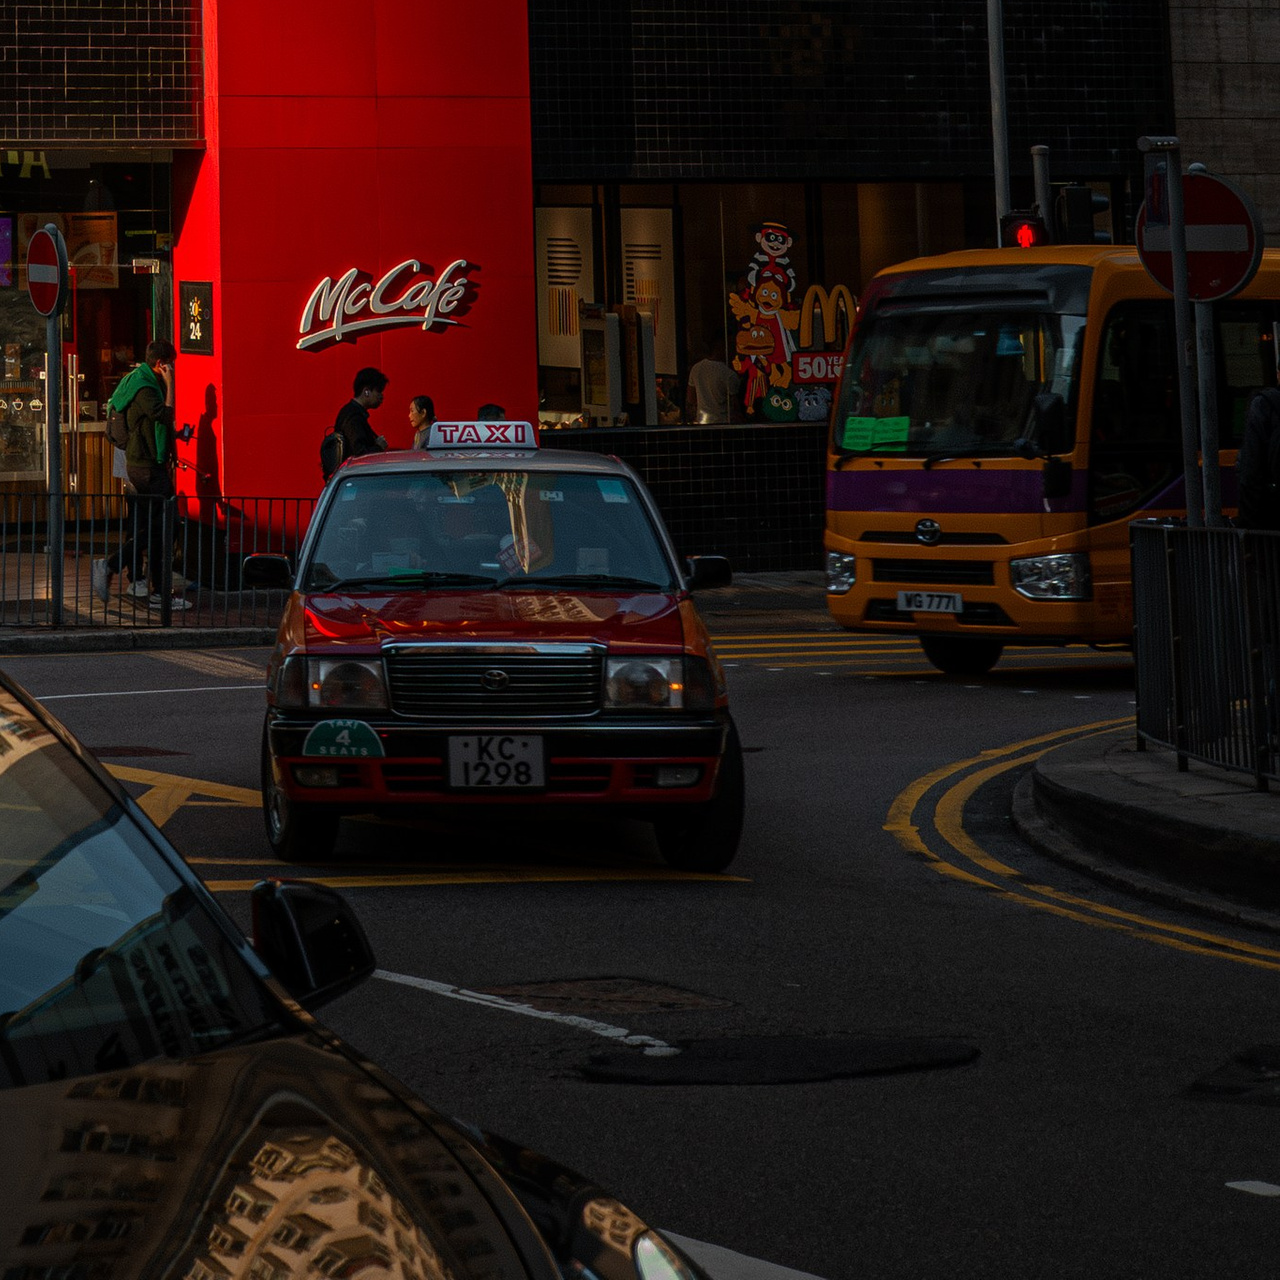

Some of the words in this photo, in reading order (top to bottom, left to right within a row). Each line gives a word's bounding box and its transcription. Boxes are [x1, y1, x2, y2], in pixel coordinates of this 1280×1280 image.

[296, 258, 469, 349] McCafé
[189, 322, 202, 341] 24
[798, 356, 827, 379] 50
[438, 424, 526, 444] TAXI
[328, 720, 358, 731] TAXI
[335, 729, 352, 746] 4
[320, 745, 369, 757] SEATS
[477, 737, 516, 761] KC
[464, 761, 532, 787] 1298
